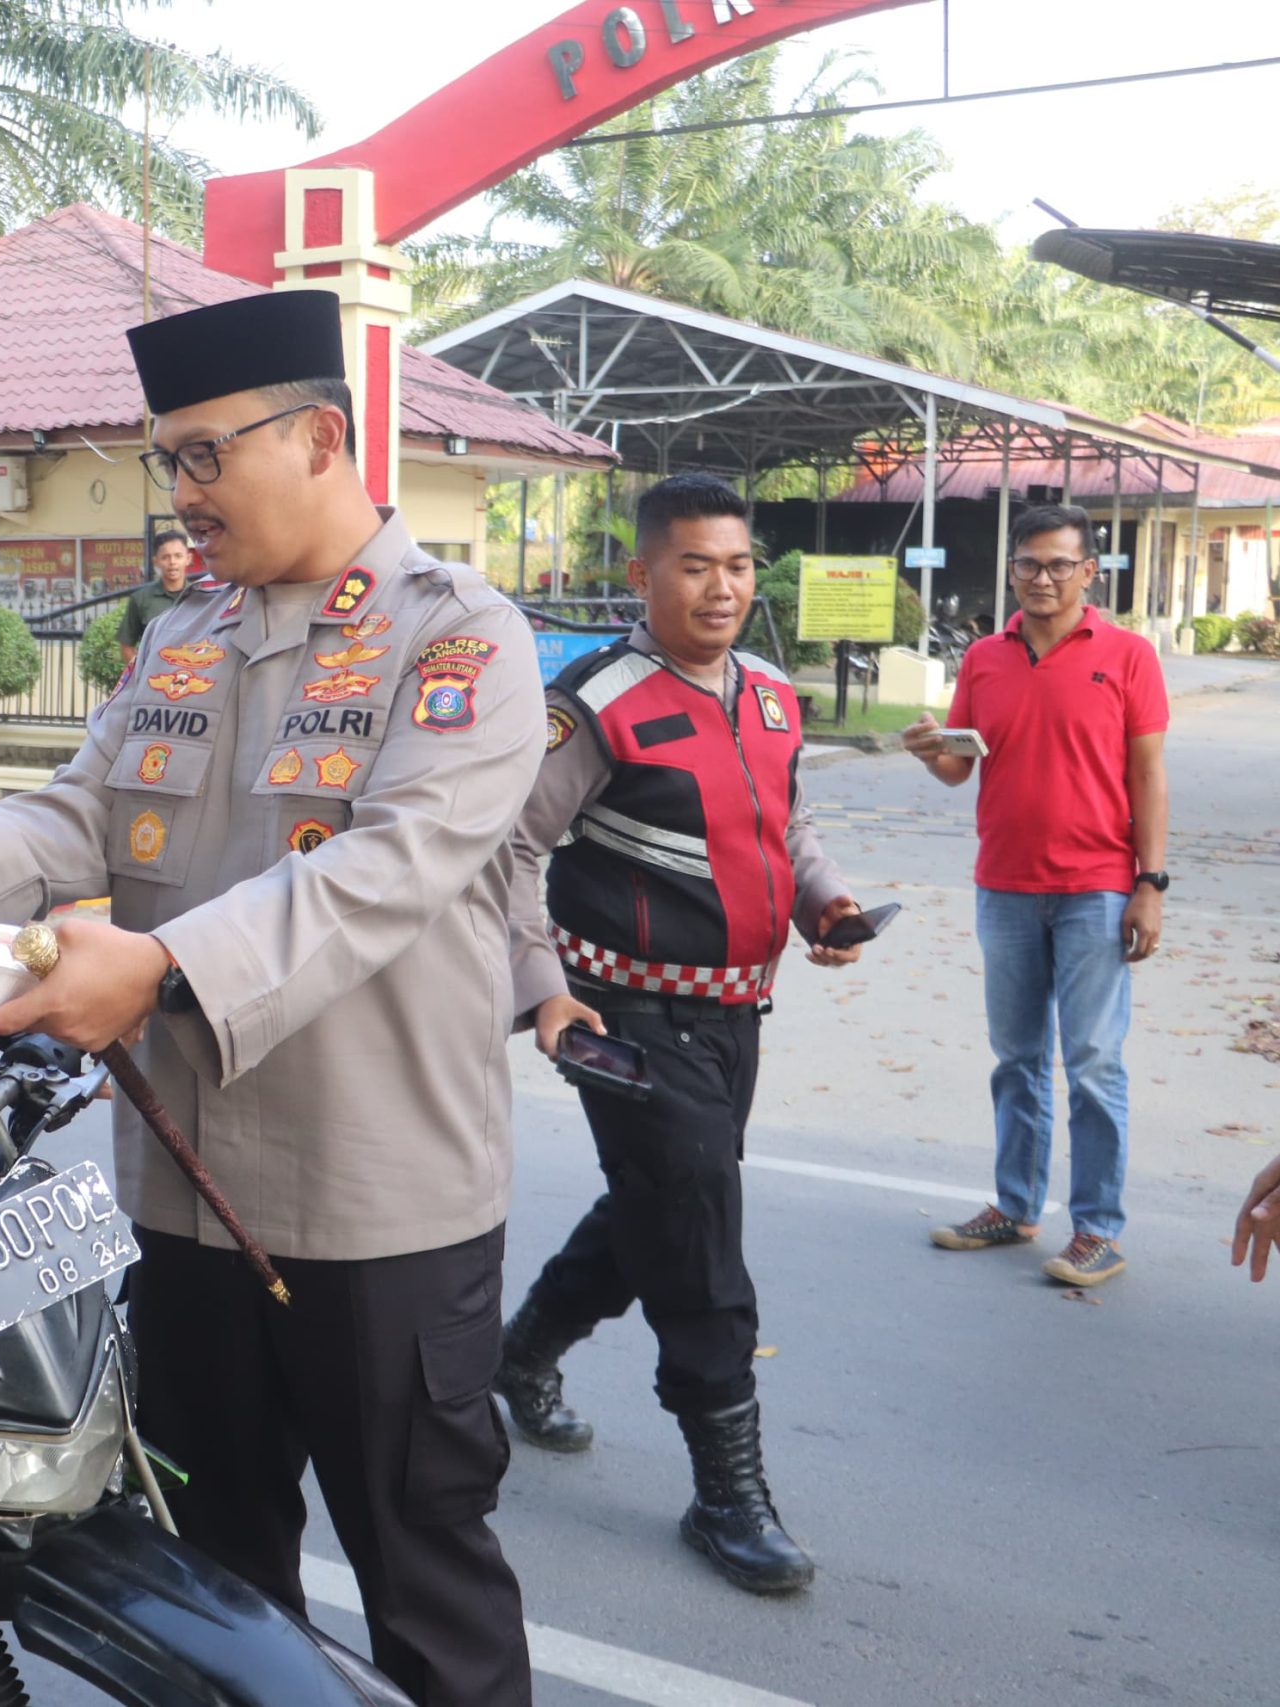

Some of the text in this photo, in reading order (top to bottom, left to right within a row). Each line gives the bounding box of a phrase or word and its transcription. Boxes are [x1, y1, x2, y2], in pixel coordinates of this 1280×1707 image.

[420, 639, 489, 660] POLRES
[428, 647, 479, 661] LANGKAT
[132, 708, 208, 737] DAVID
[283, 709, 373, 738] POLRI
[37, 1257, 79, 1294] 08
